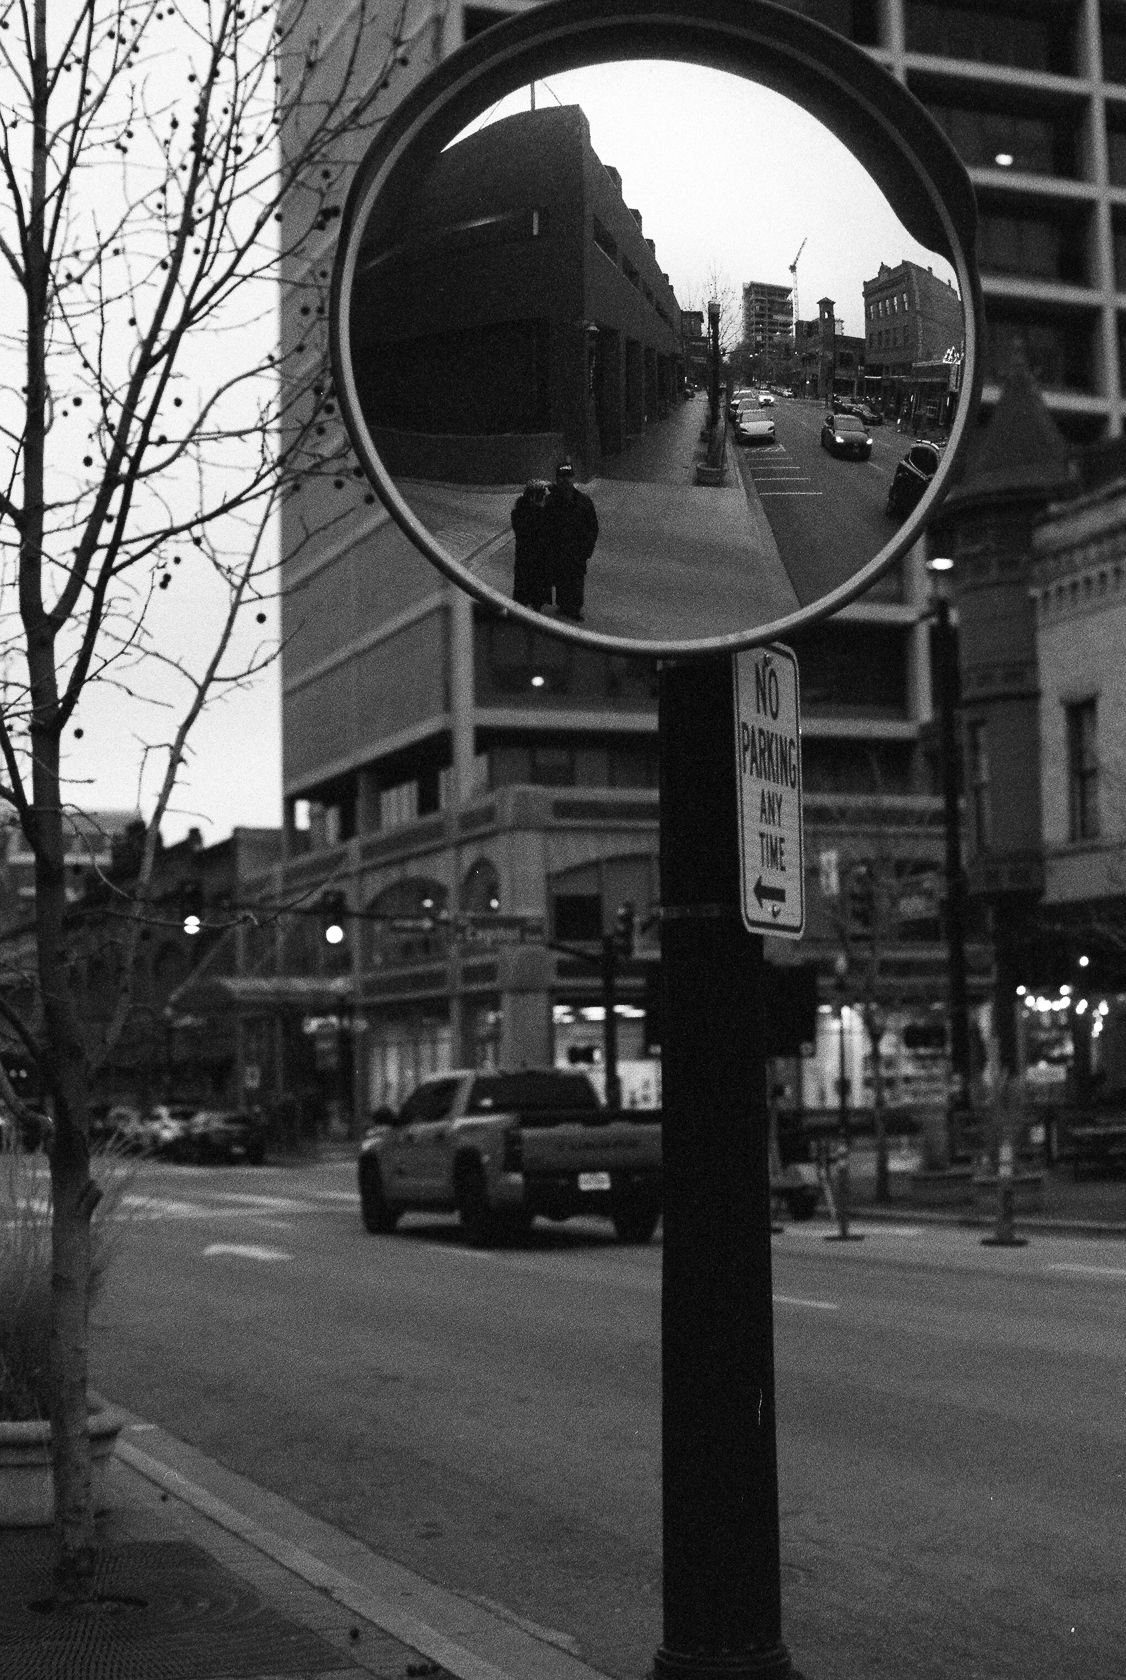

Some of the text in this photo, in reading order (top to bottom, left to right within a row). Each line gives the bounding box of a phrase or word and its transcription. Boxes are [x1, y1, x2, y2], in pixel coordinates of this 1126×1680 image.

[755, 662, 779, 720] NO
[741, 721, 796, 789] PARKING
[760, 789, 783, 827] ANY
[759, 832, 786, 871] TIME
